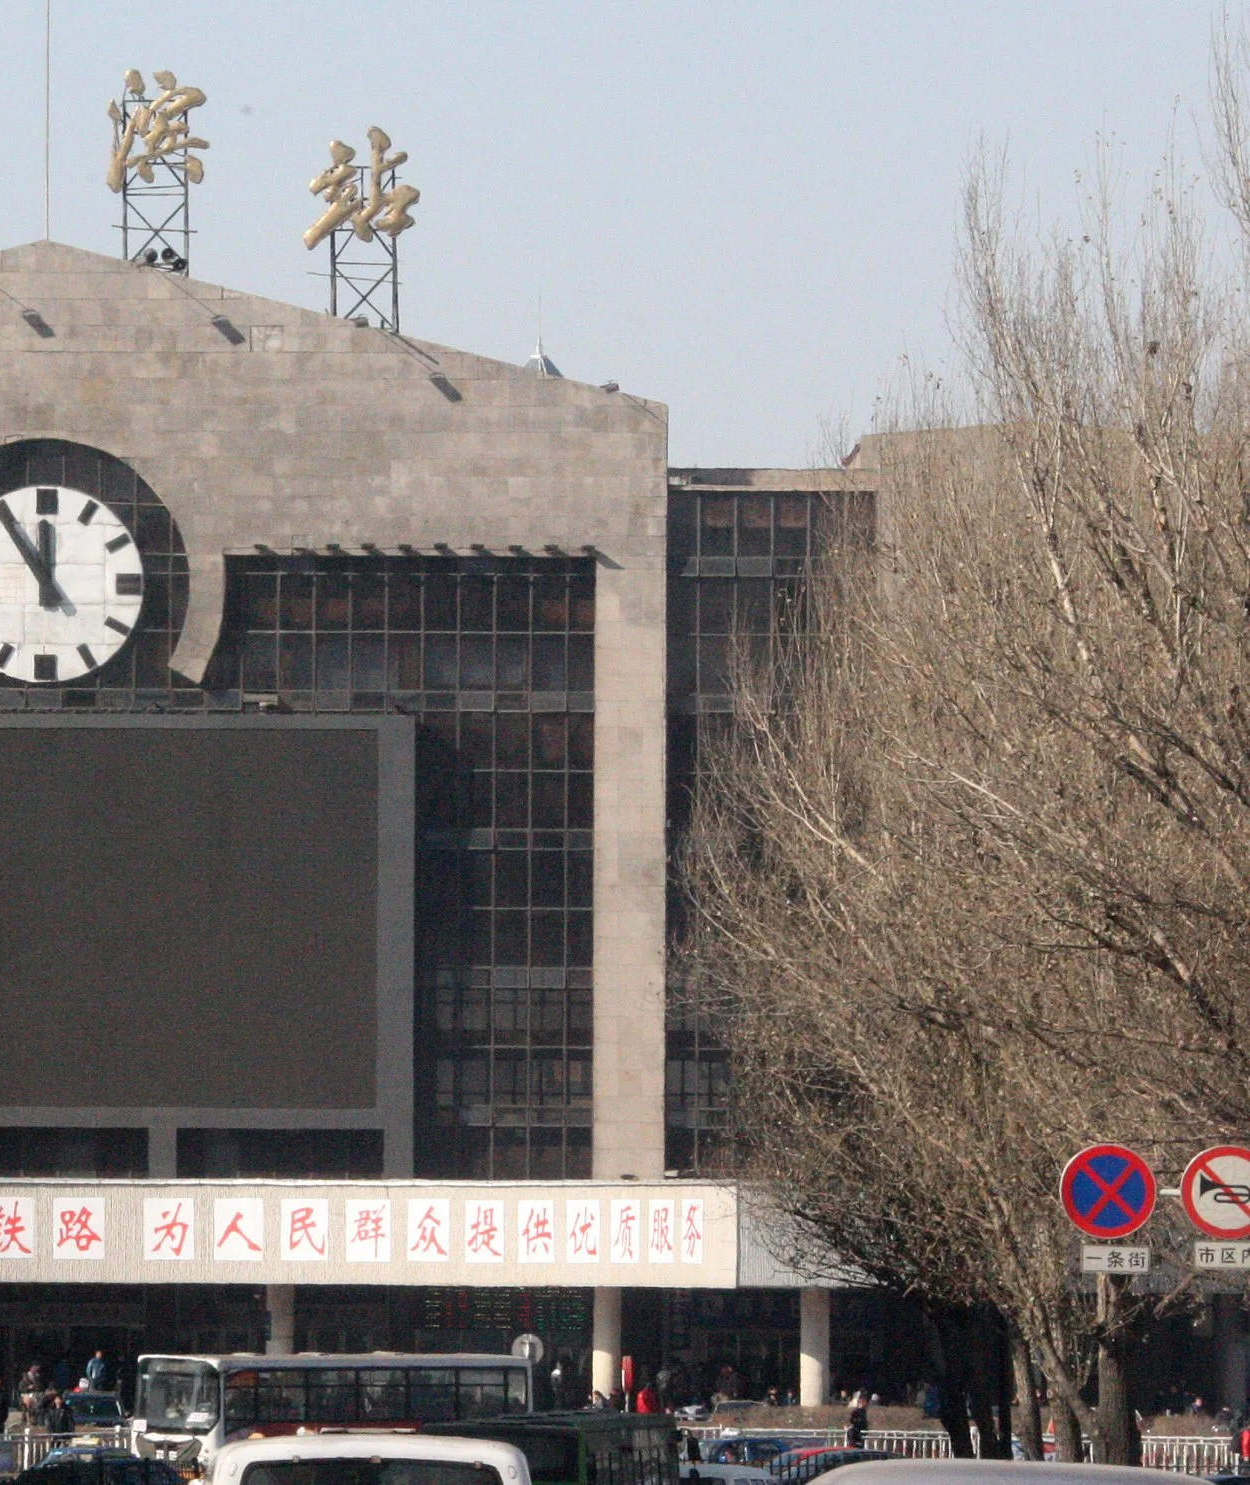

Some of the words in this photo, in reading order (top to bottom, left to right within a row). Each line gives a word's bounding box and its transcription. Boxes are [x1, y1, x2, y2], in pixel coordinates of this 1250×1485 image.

[150, 1202, 702, 1259] 为人民群众提供优质服务
[1085, 1251, 1146, 1268] 一条街
